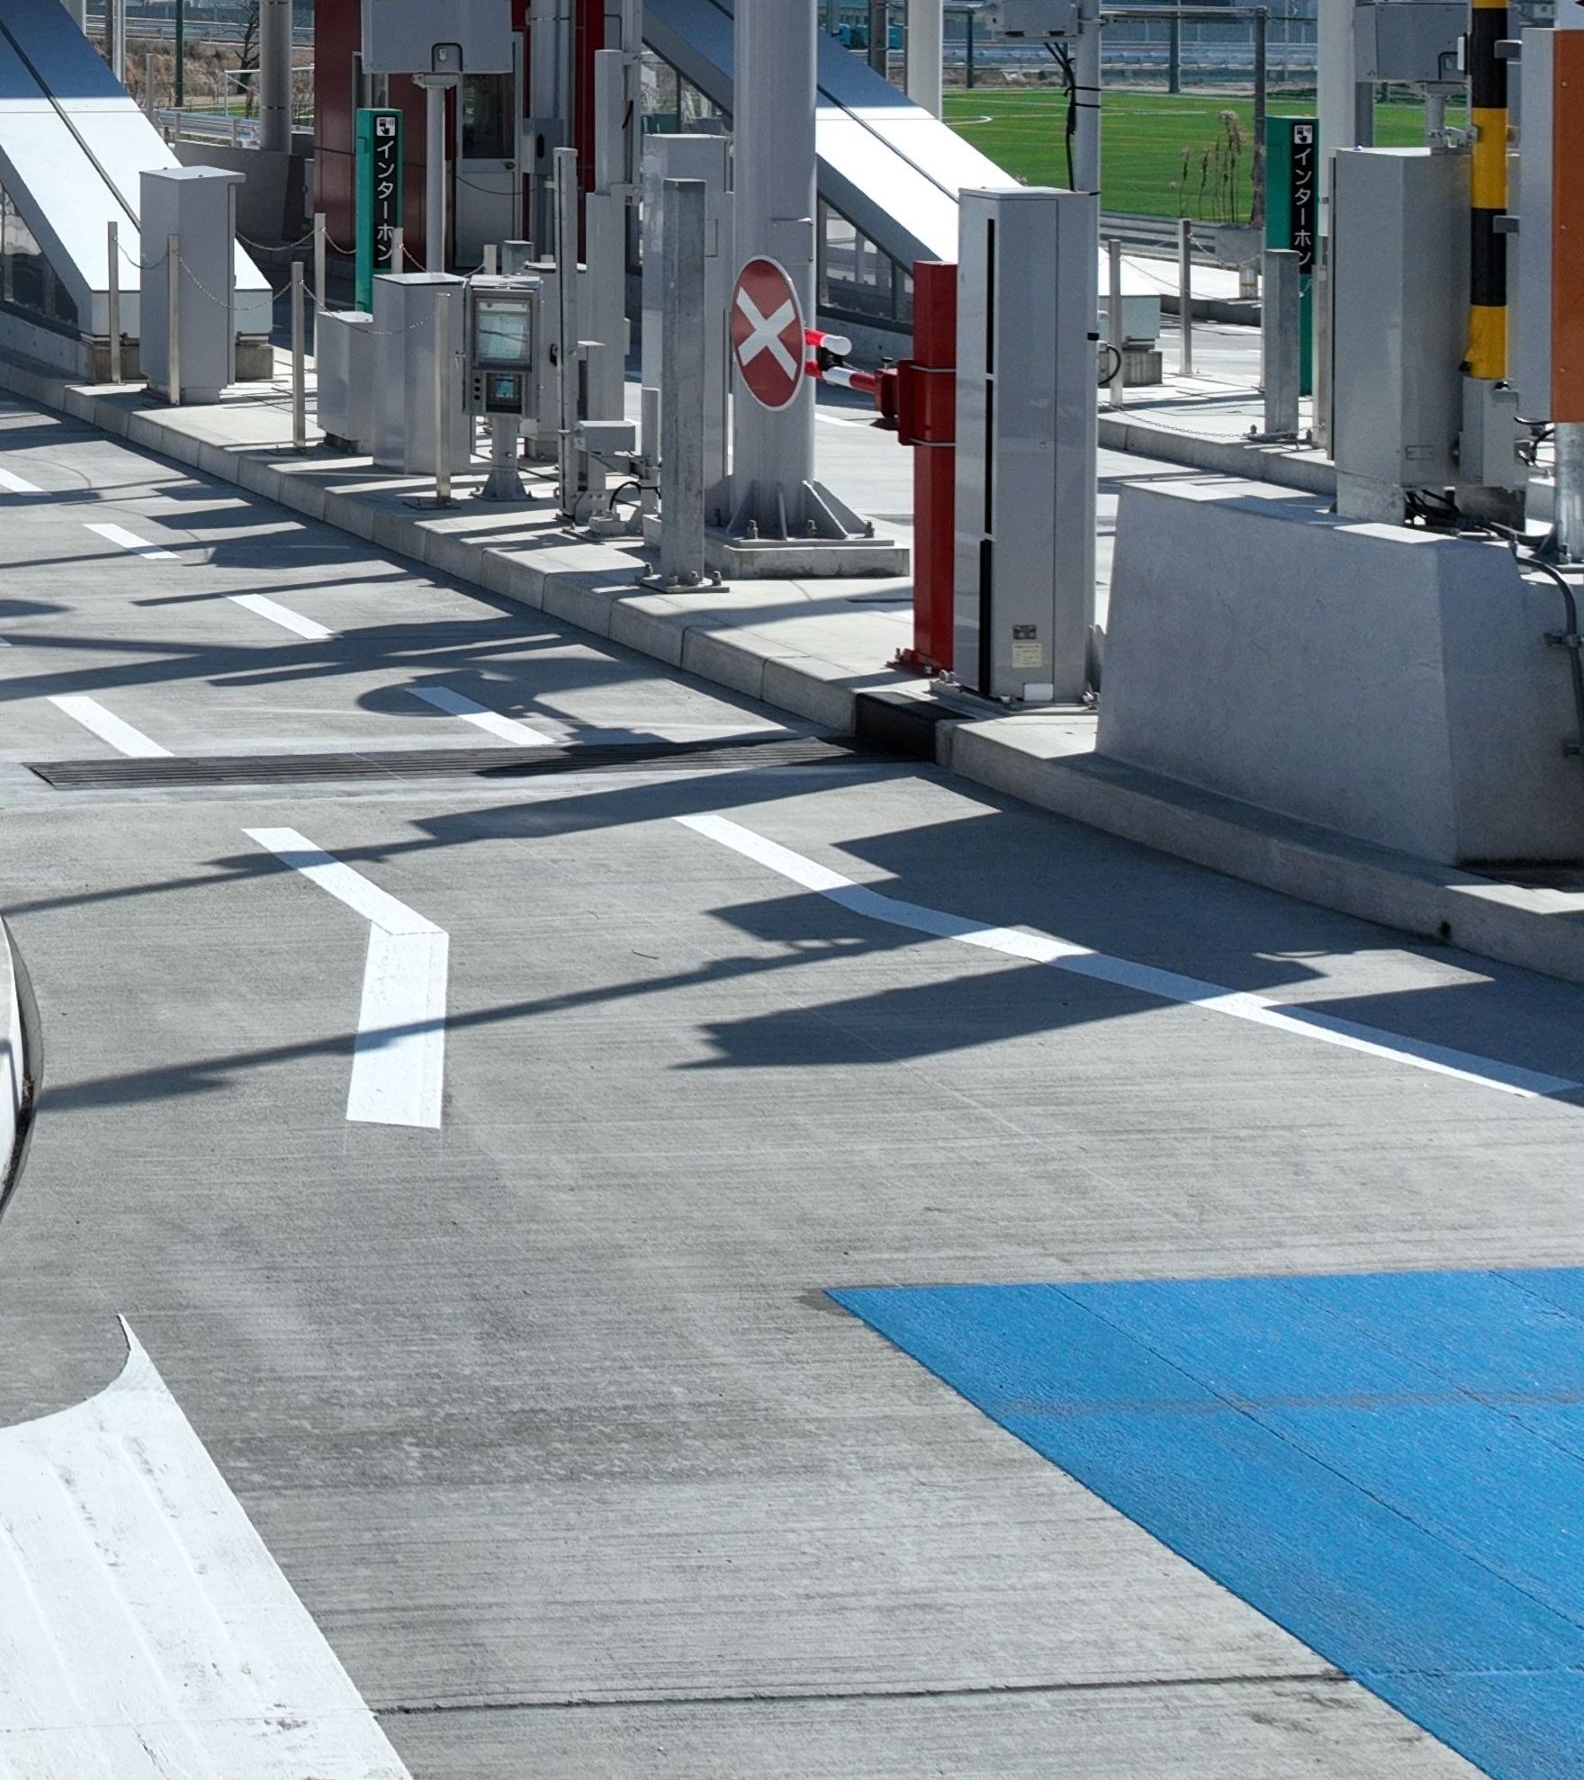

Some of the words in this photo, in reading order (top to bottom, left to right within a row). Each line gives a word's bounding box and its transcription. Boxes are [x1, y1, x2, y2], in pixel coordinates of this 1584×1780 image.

[376, 140, 395, 262] インターホン
[1294, 148, 1312, 265] インターホン
